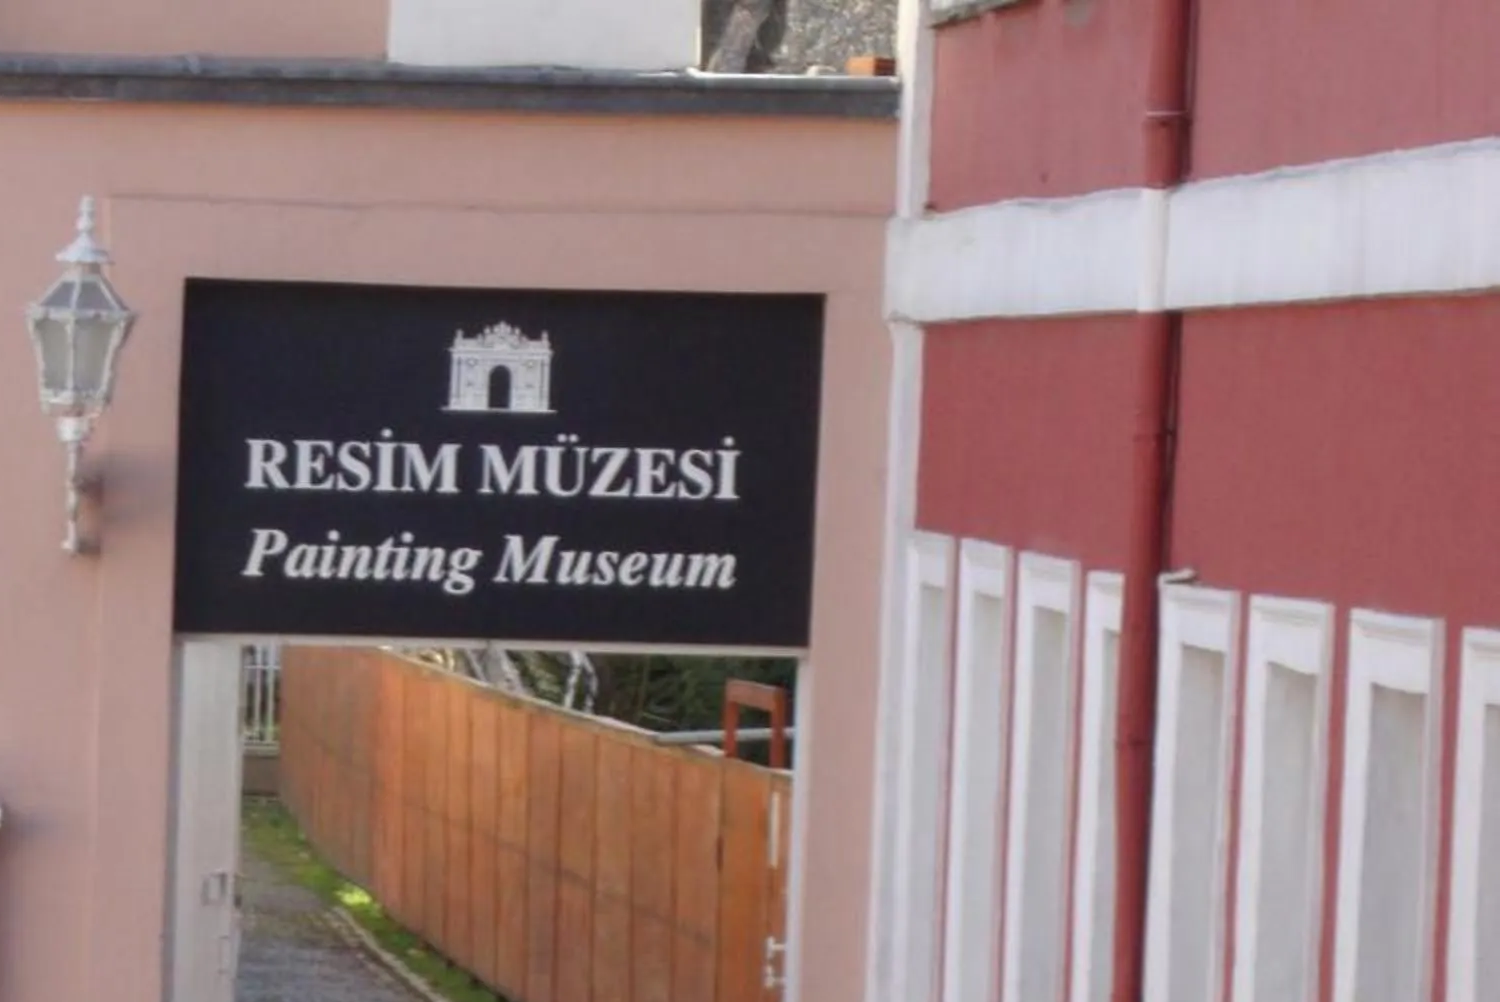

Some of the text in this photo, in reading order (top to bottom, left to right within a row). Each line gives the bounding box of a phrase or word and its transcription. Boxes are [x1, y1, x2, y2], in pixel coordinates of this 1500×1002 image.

[244, 428, 741, 500] RESİM MÜZESİ
[241, 528, 737, 595] Painting Museum
